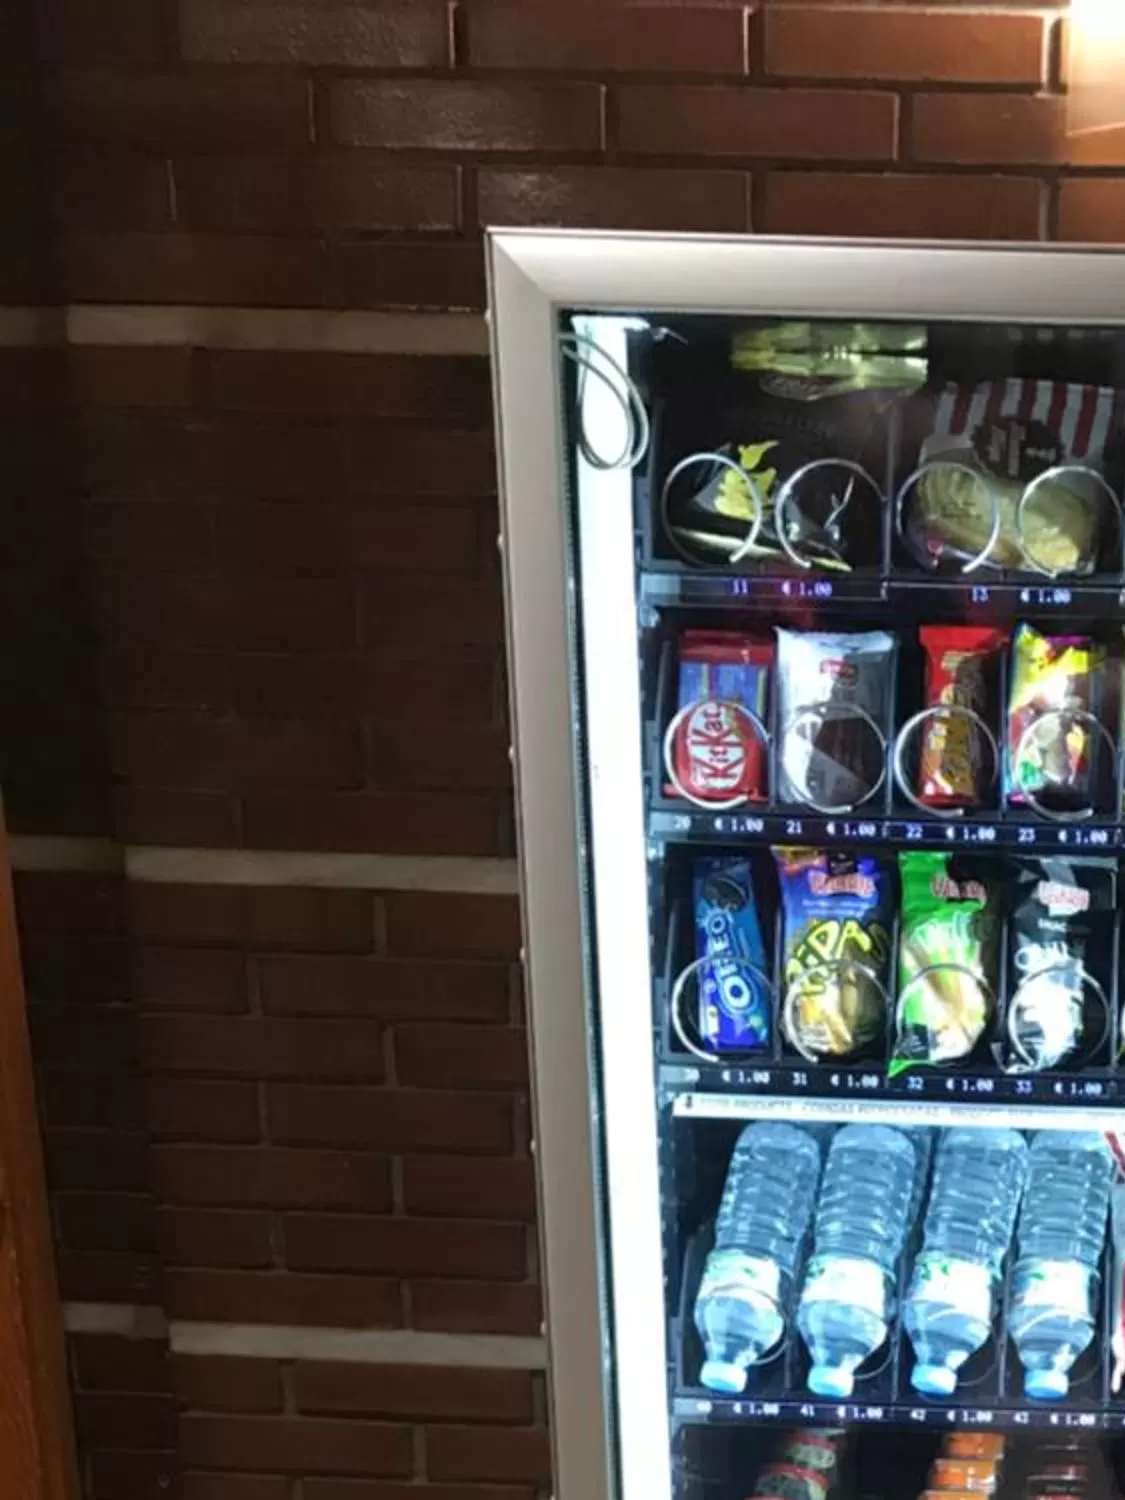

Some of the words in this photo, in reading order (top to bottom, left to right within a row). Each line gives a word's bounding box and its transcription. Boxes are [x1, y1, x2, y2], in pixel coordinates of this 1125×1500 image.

[730, 818, 764, 833] 1.00
[786, 820, 803, 834] 21
[844, 823, 877, 837] 1.00
[905, 823, 923, 838] 22
[963, 827, 996, 841] 1.00
[1018, 828, 1036, 843] 23
[1075, 830, 1108, 845] 1.00
[737, 1070, 771, 1085] 1.00
[793, 1072, 808, 1086] 31
[847, 1074, 880, 1089] 1.00
[907, 1076, 925, 1091] 32
[962, 1079, 995, 1093] 1.00
